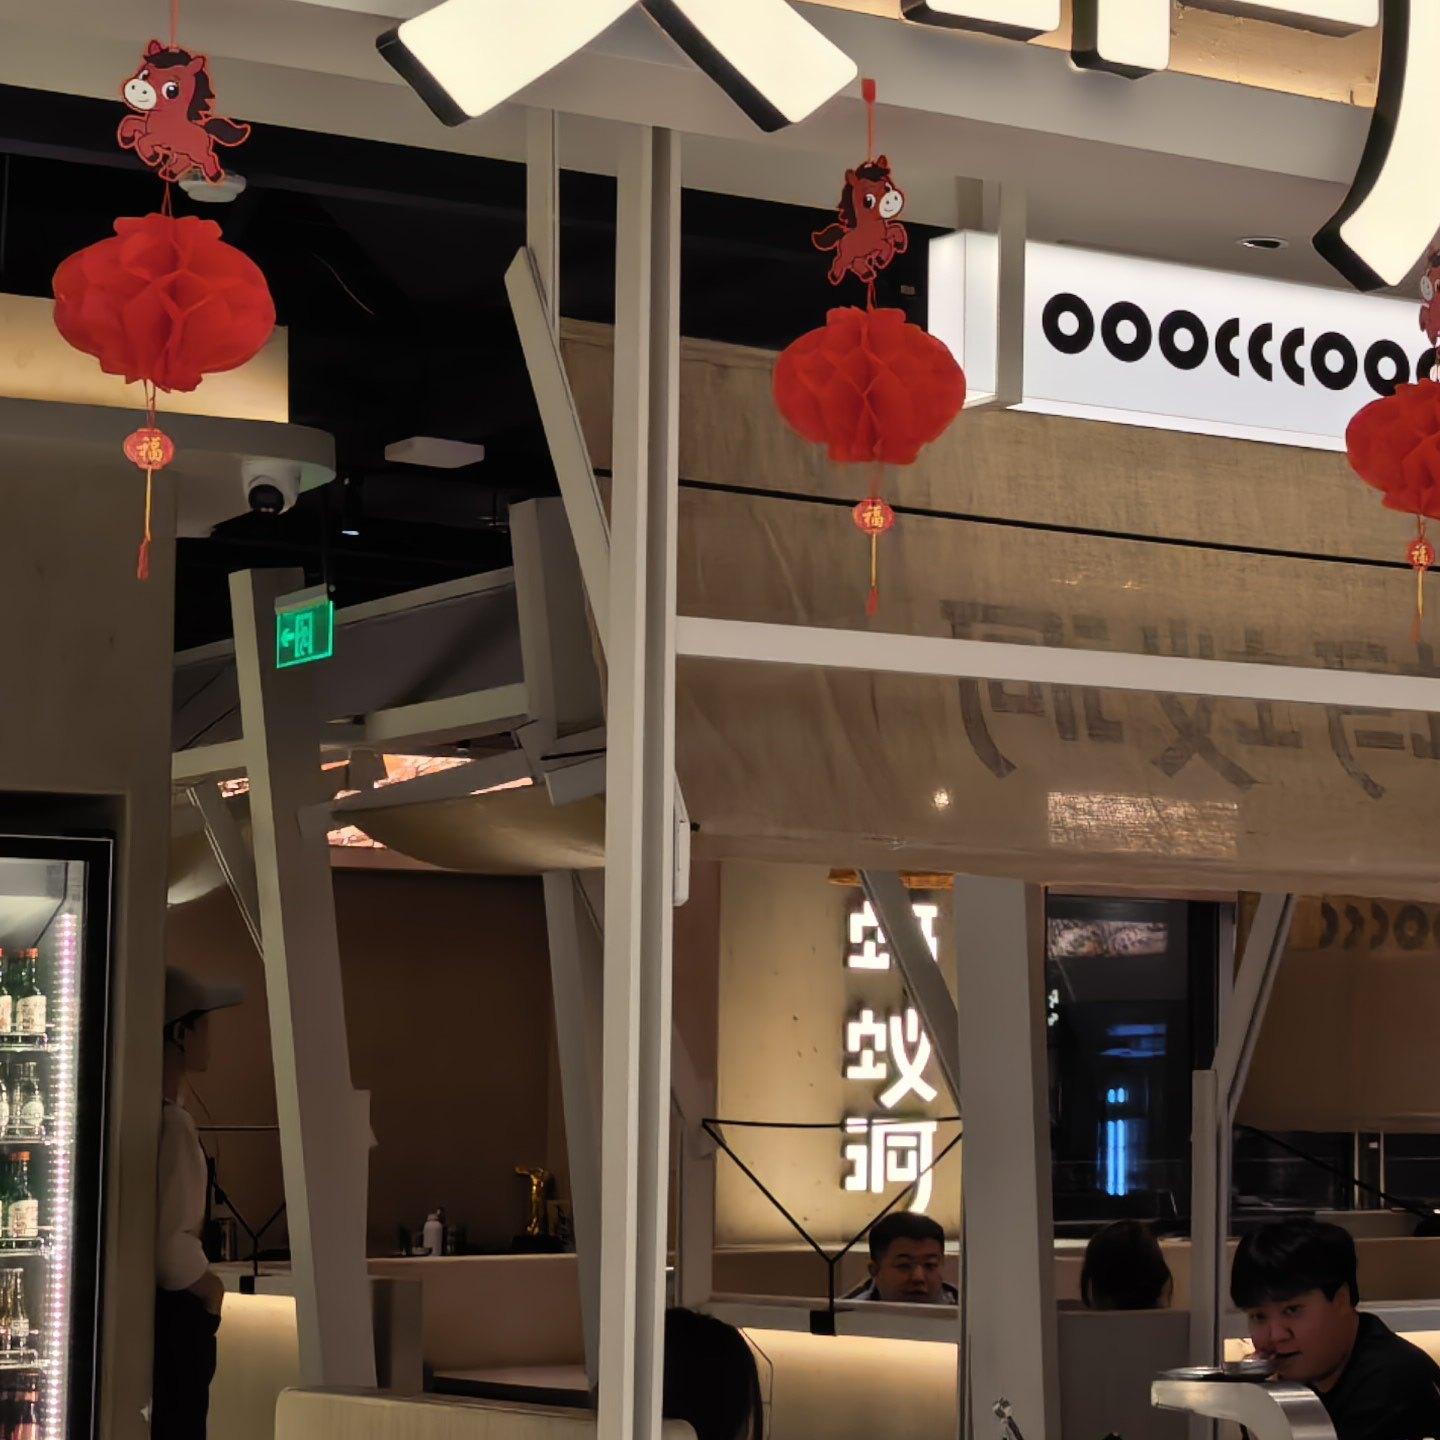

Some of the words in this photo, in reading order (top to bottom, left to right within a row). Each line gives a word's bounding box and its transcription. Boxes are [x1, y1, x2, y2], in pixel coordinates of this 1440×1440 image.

[136, 436, 164, 463] 福
[863, 504, 884, 528] 福
[1409, 542, 1428, 565] 福
